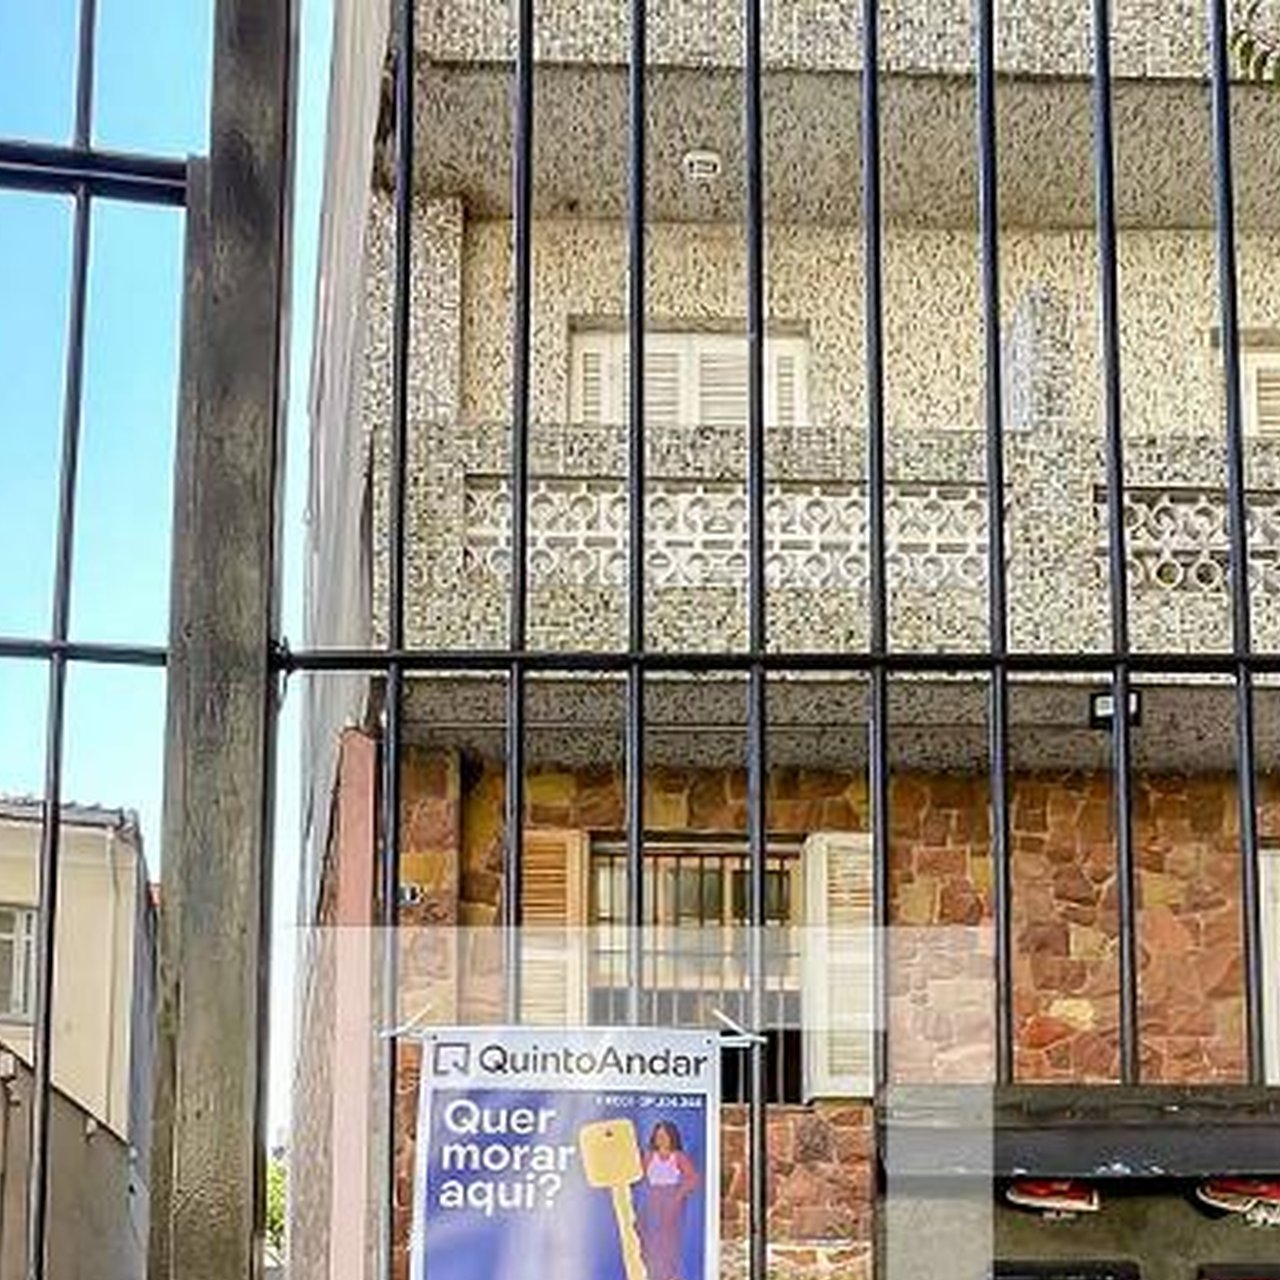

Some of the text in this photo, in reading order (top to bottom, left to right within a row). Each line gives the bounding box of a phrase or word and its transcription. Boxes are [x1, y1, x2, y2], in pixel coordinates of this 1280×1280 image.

[479, 1045, 709, 1076] QuintoAndar
[445, 1100, 556, 1135] Quer
[441, 1142, 576, 1172] morar
[438, 1173, 562, 1216] aqui?
